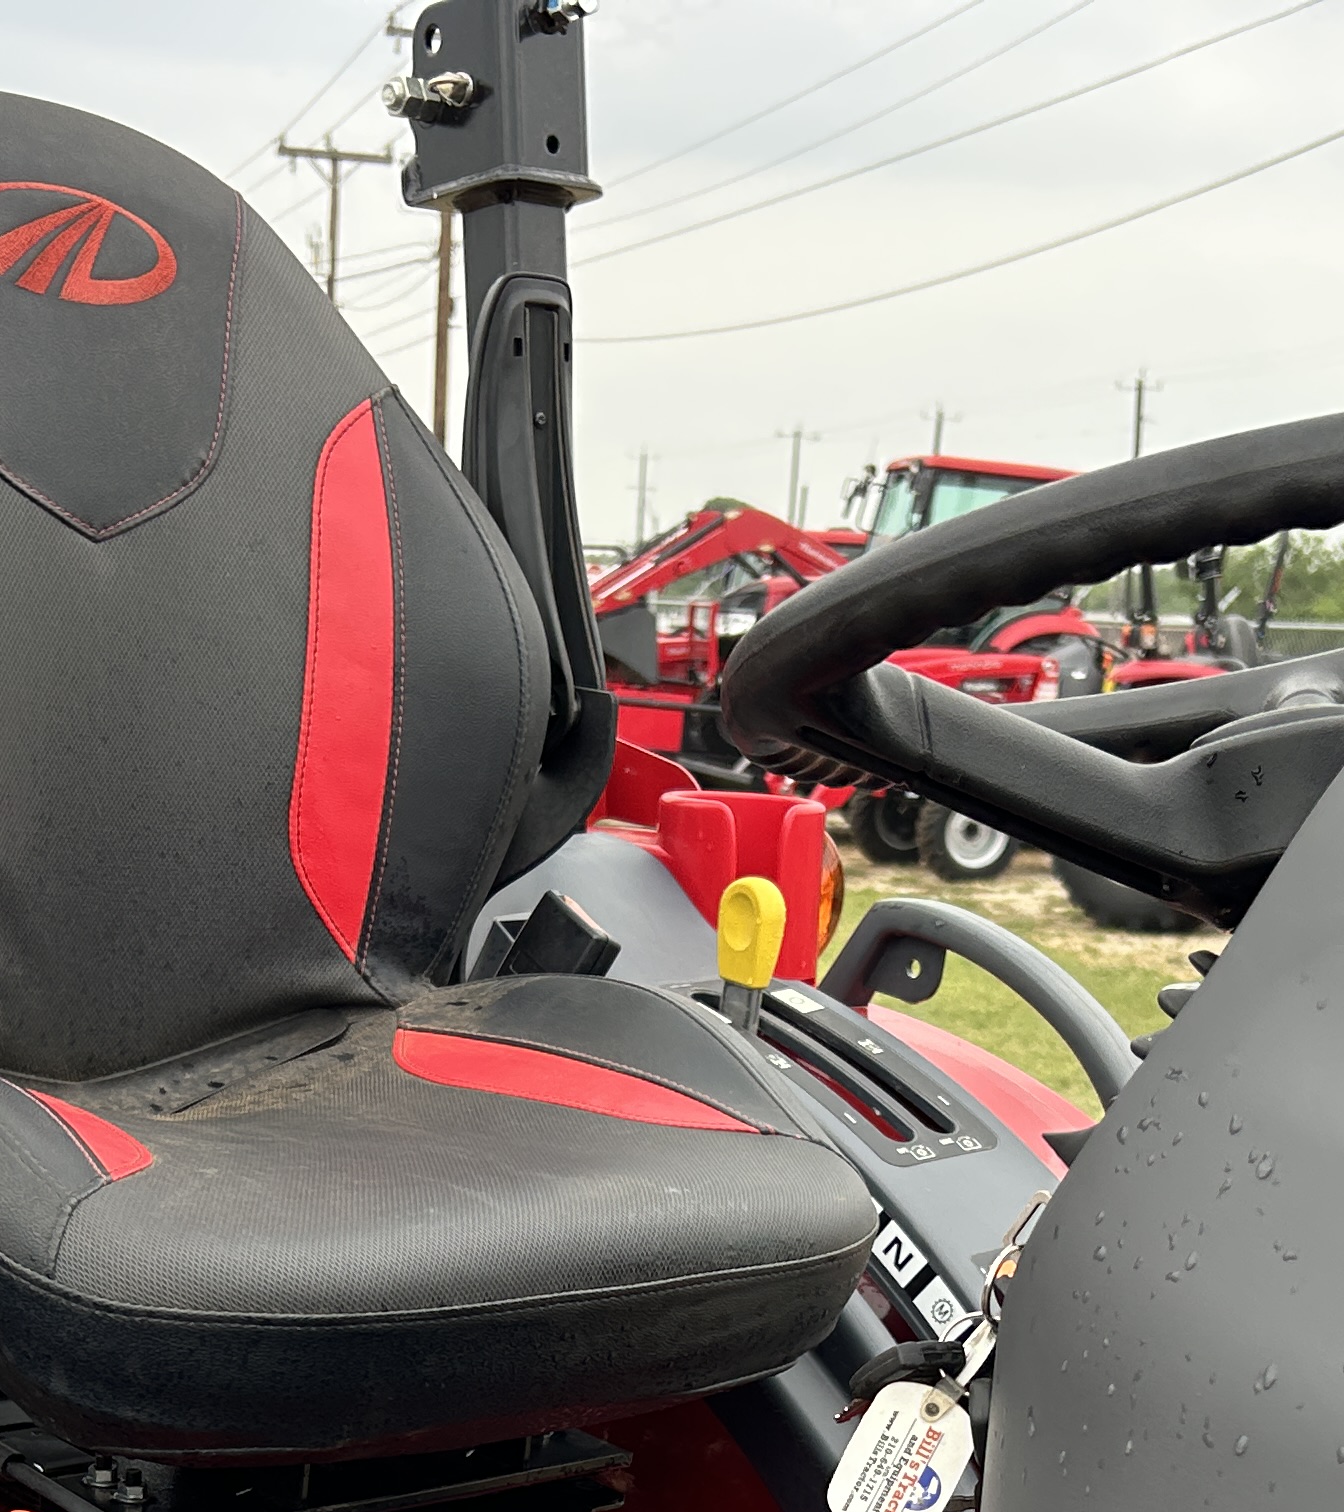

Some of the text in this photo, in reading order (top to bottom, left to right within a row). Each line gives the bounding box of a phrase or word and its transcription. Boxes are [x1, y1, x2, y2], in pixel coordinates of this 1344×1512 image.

[860, 1436, 898, 1501] 210-649-1715
[872, 1434, 917, 1512] and Equipment
[909, 1426, 941, 1470] Bill's
